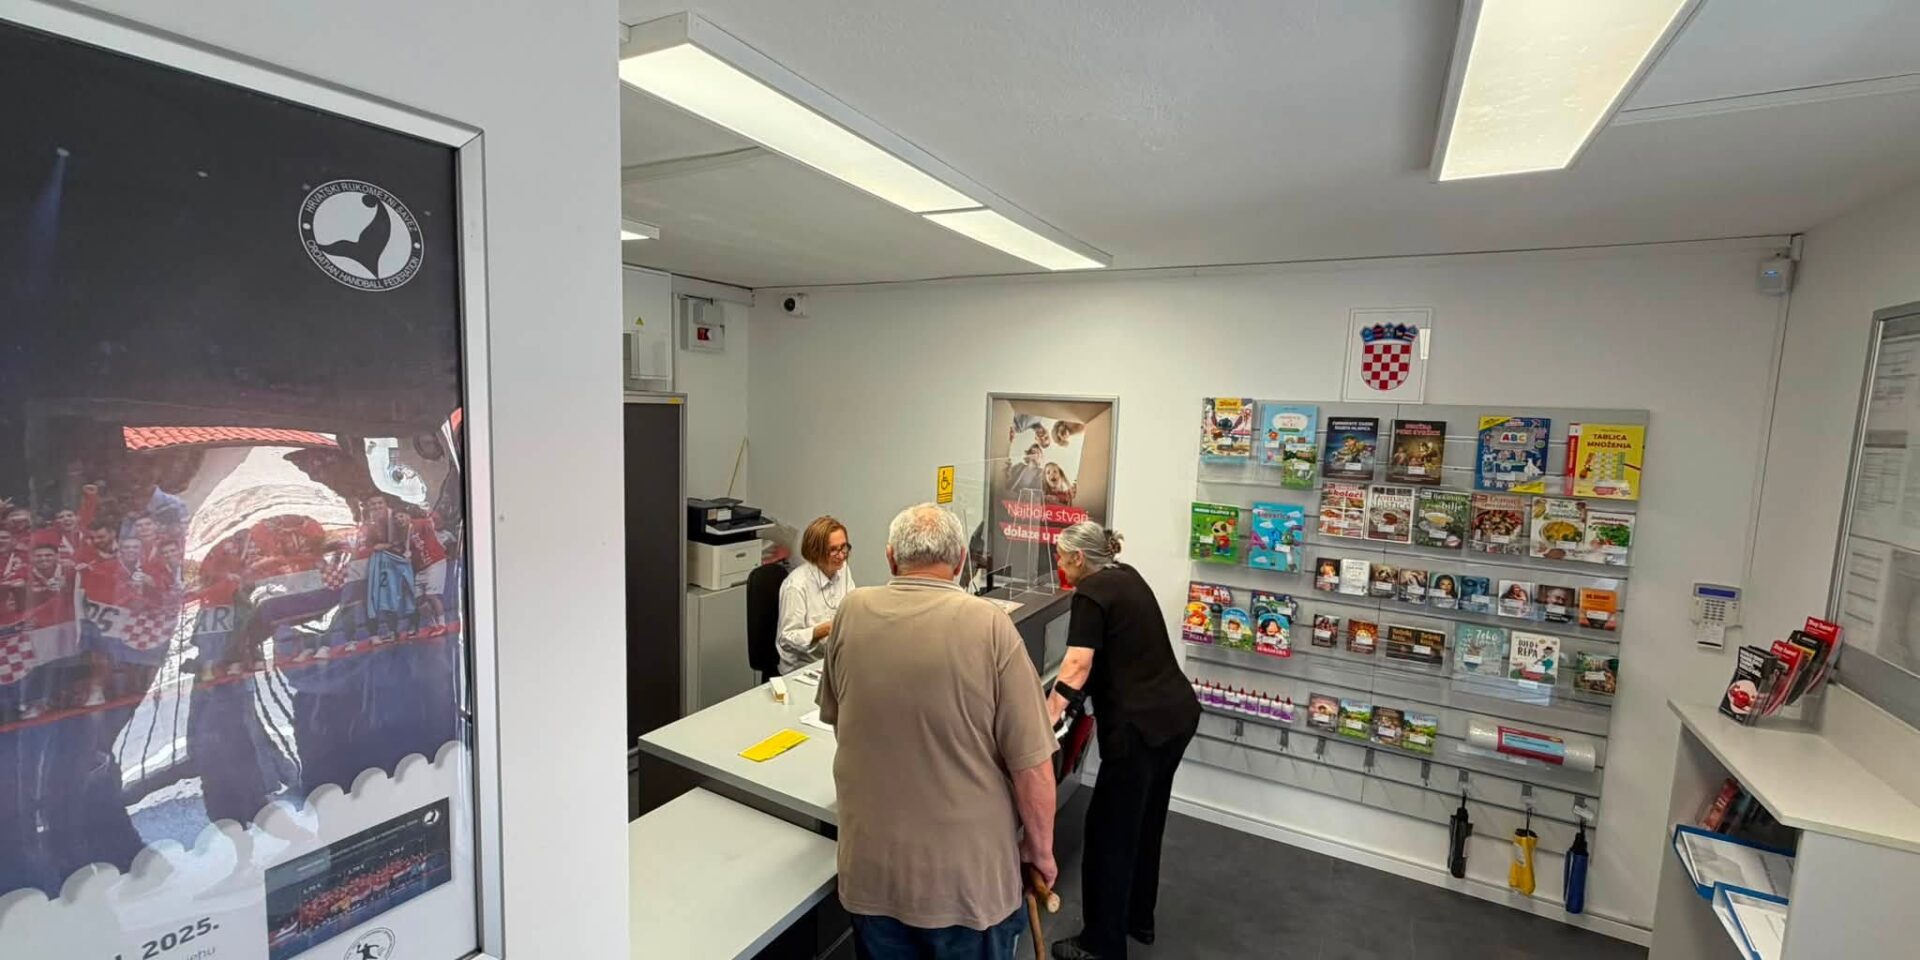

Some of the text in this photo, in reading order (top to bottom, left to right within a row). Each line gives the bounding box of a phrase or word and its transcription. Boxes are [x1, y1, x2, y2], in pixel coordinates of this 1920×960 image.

[304, 182, 418, 232] HRVATSKI RUKOMETNI SAVEZ
[306, 239, 420, 289] CROATIAN HANDBALL FEDERATION
[1501, 432, 1527, 444] ABC
[1587, 440, 1632, 449] MNOŽENJA
[1593, 433, 1628, 441] TABLICA
[1007, 503, 1089, 523] Najbolje stvari
[1003, 525, 1039, 539] dolaze
[1042, 532, 1051, 540] u
[141, 916, 220, 960] 2025.
